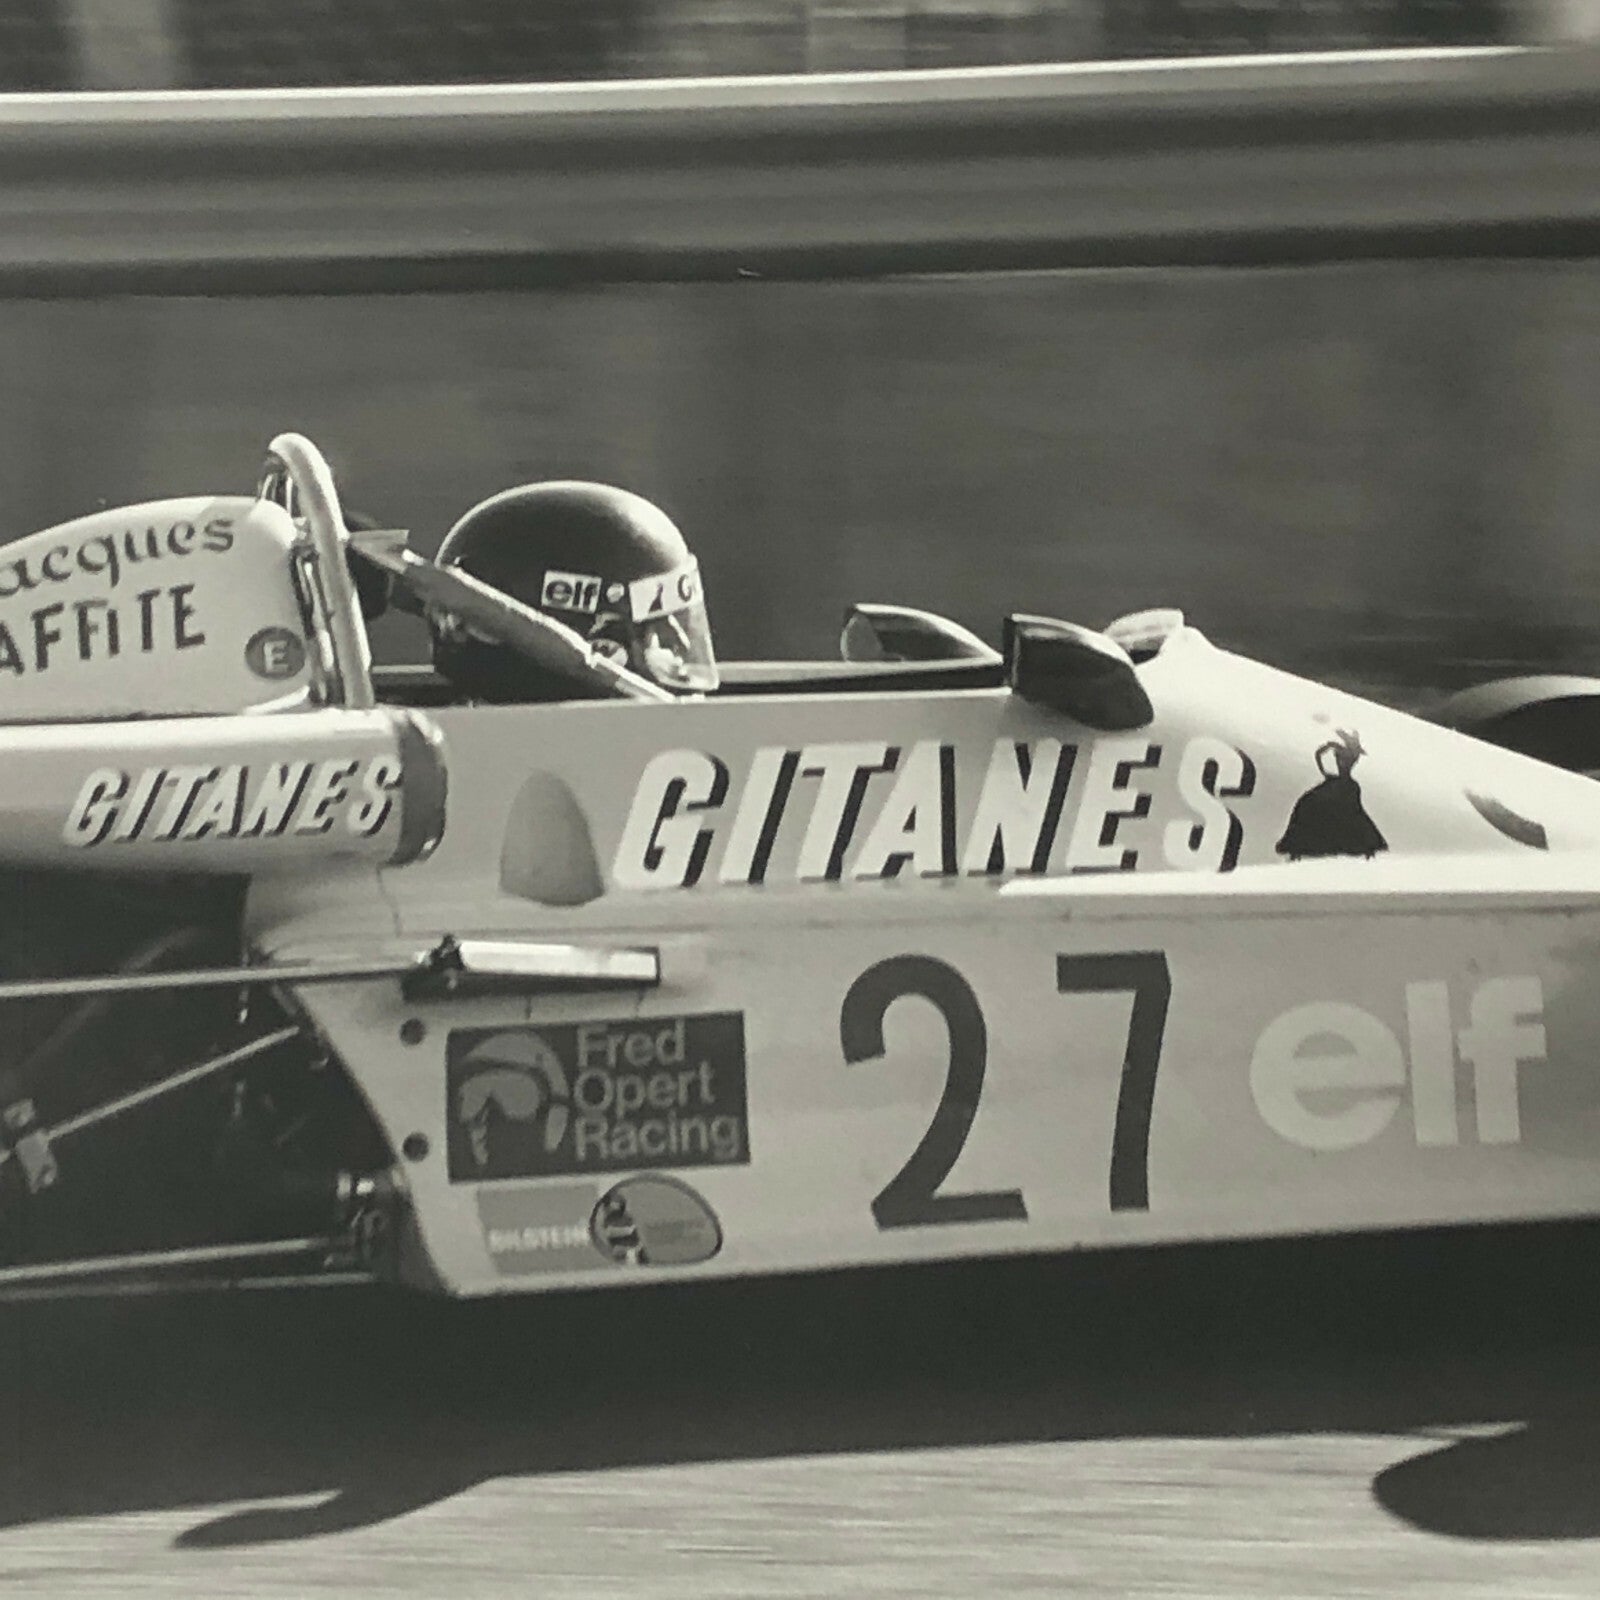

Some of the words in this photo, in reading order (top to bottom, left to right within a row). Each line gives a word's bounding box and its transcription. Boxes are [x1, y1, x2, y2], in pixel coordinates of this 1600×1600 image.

[545, 580, 599, 610] elf
[62, 756, 402, 847] GITANES
[612, 737, 1256, 889] GITANES
[575, 1017, 686, 1068] Fred
[1249, 973, 1547, 1151] elf
[572, 1058, 716, 1120] Opert
[840, 950, 1173, 1231] 27
[573, 1108, 740, 1162] Racing
